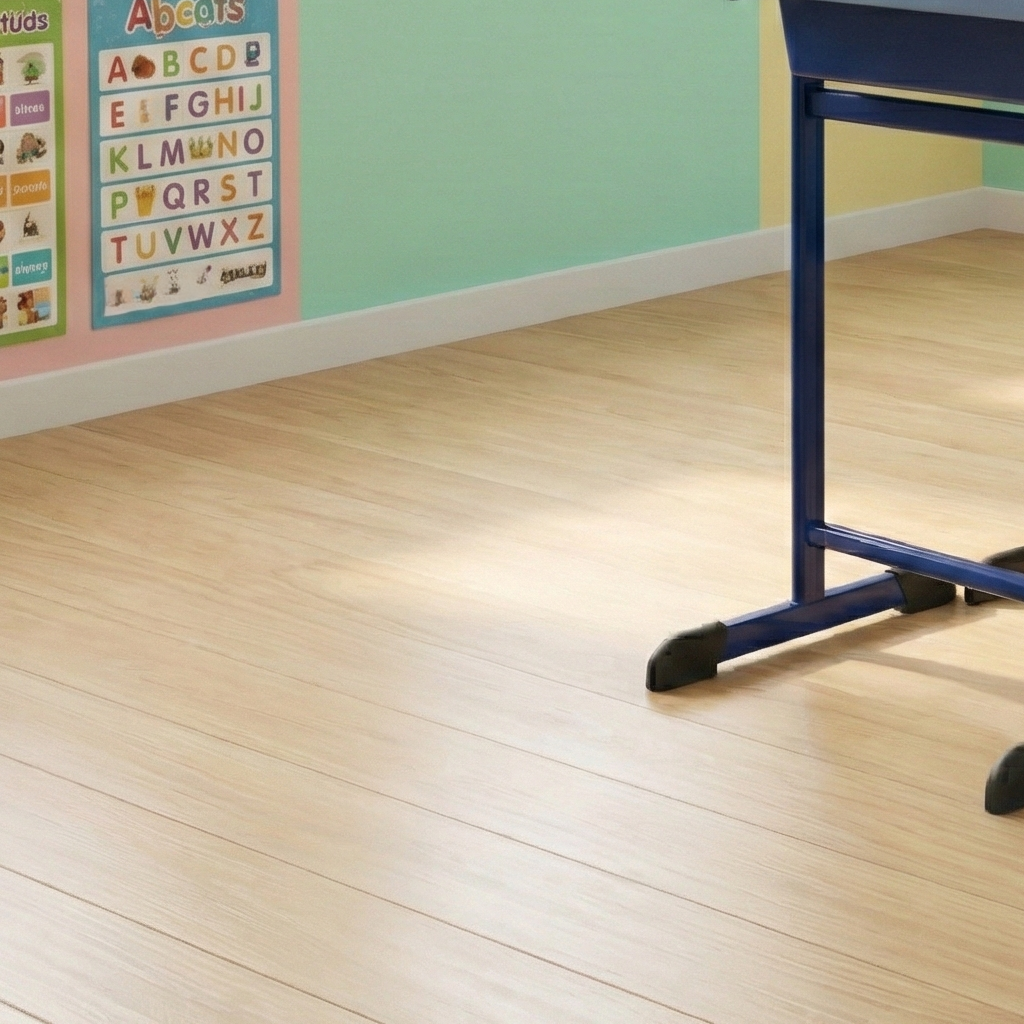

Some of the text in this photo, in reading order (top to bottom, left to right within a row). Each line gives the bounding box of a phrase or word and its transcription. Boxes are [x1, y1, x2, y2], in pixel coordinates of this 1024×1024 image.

[107, 56, 128, 84] A
[163, 50, 180, 77] B
[189, 47, 207, 73] C
[217, 44, 236, 71] D
[111, 84, 261, 128] E F G H I J
[110, 128, 264, 174] K L M N O
[111, 170, 262, 220] P Q R S T
[111, 213, 264, 264] T U V W X Z
